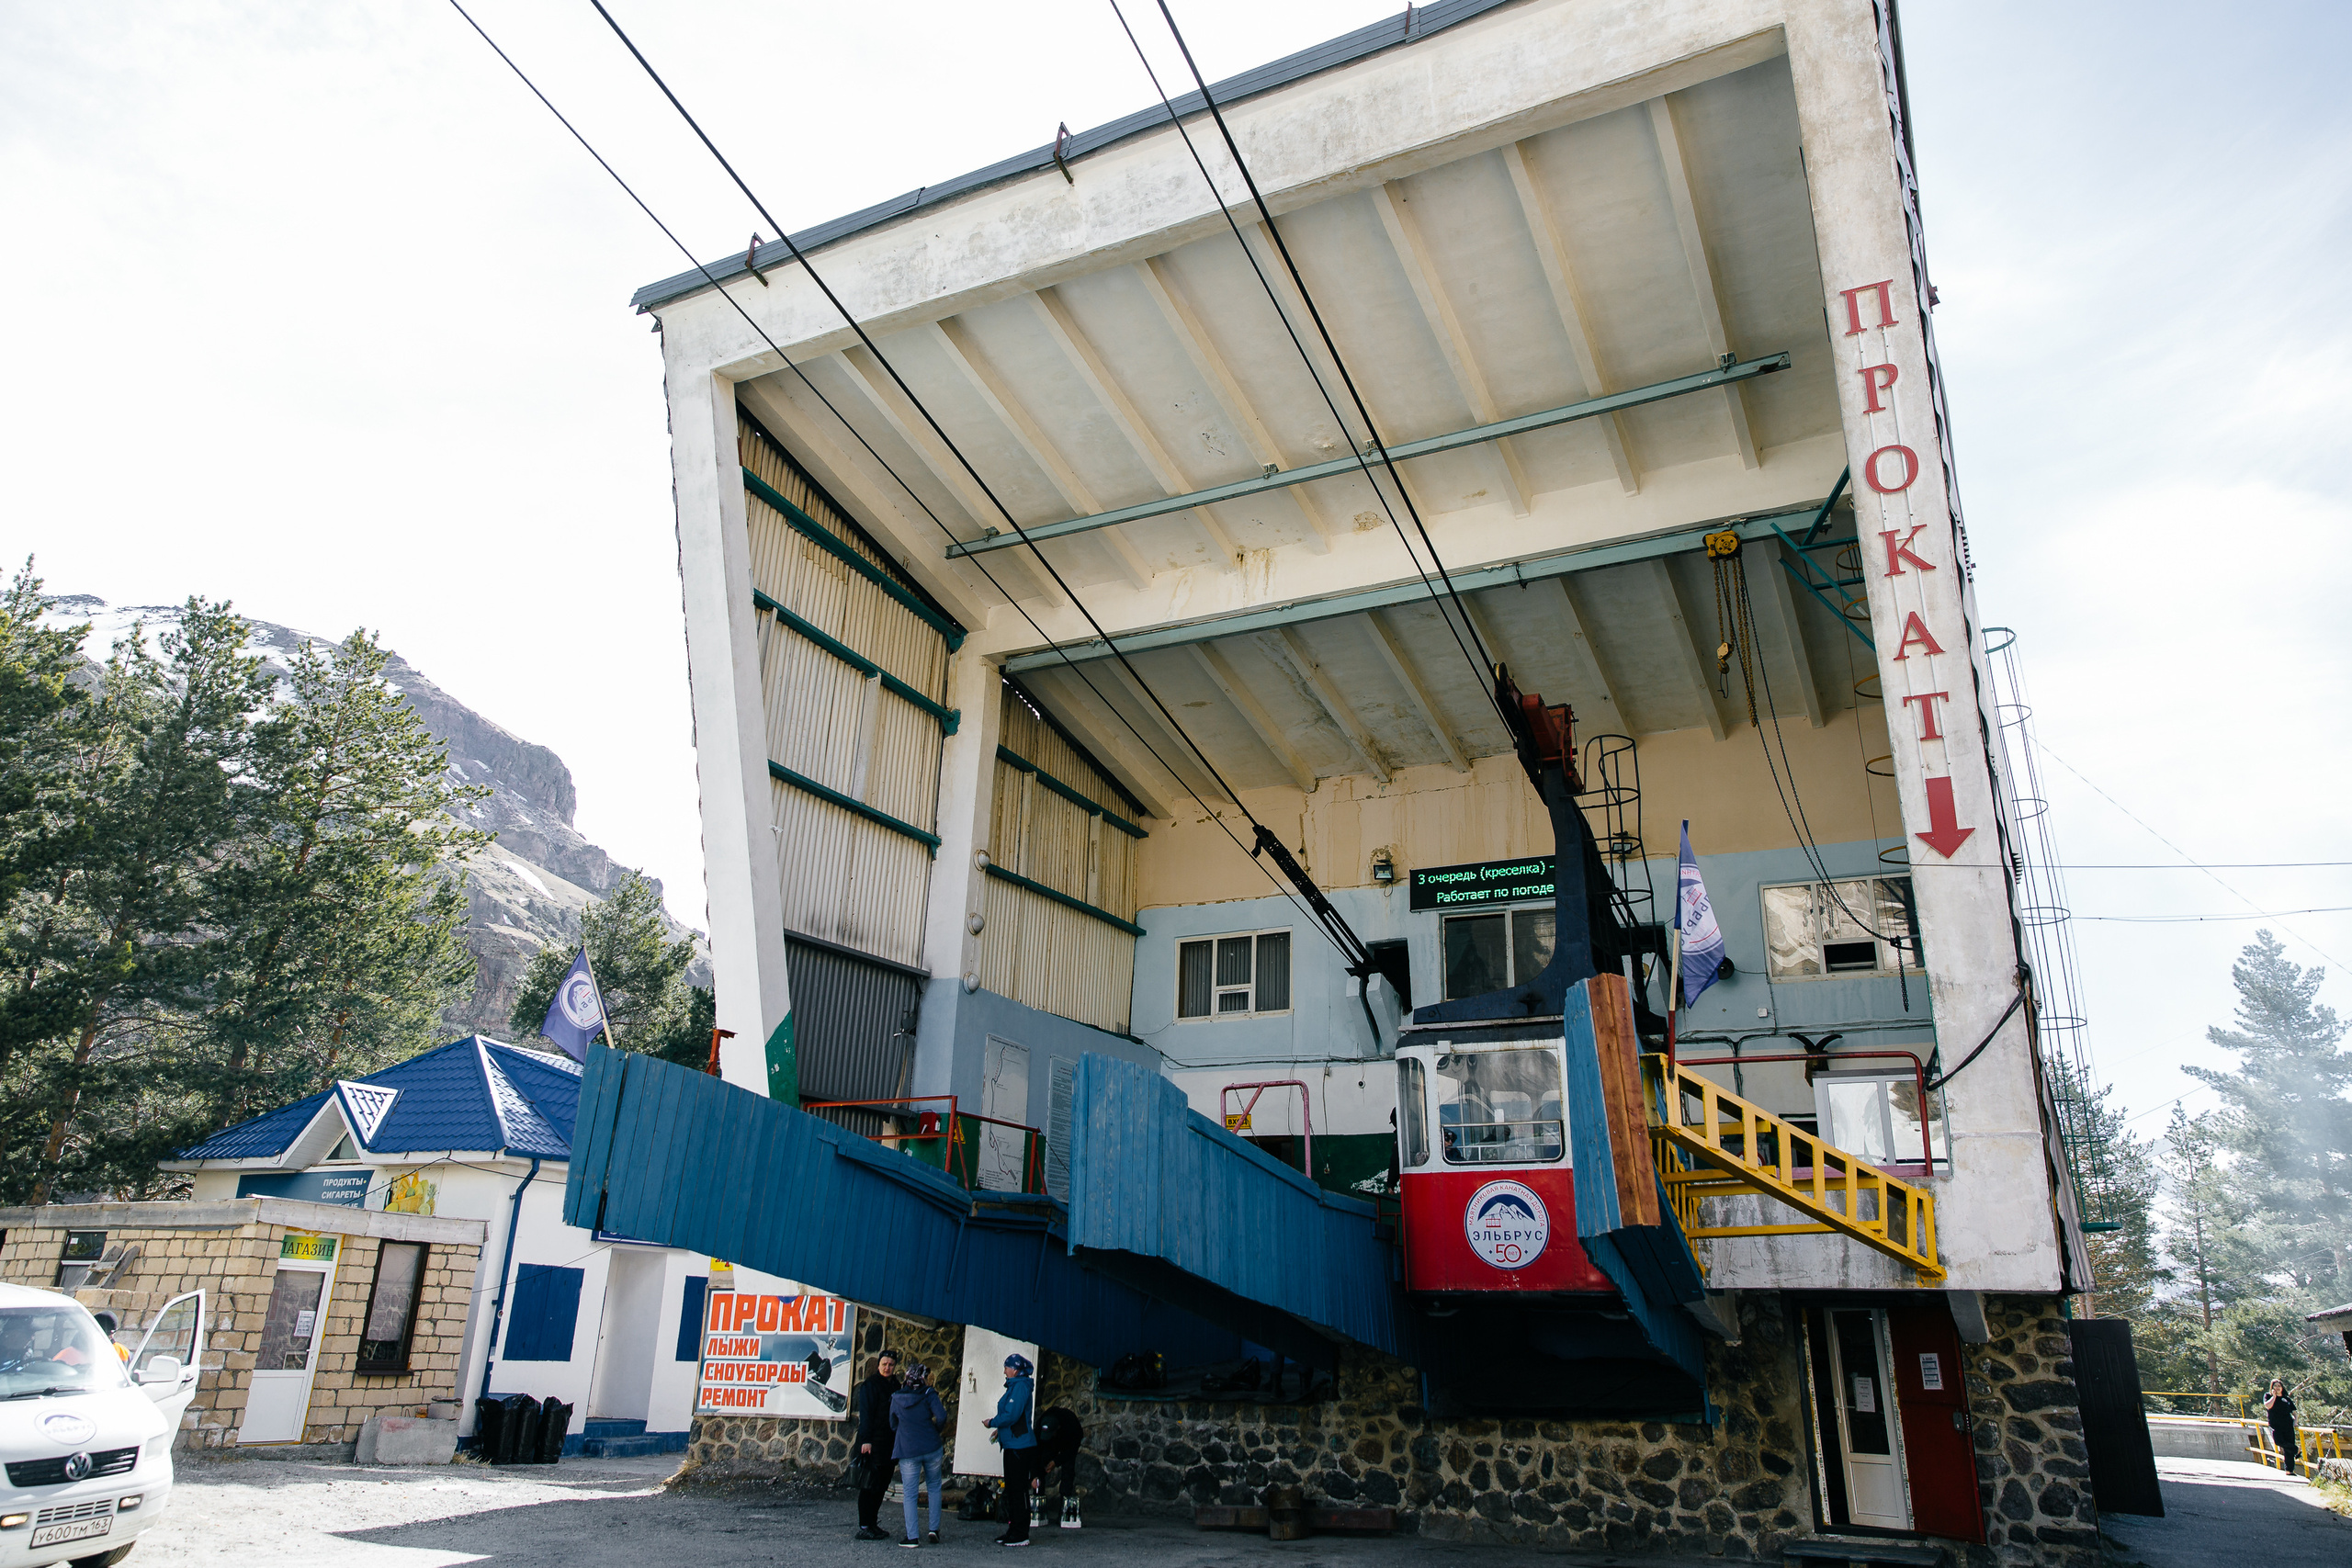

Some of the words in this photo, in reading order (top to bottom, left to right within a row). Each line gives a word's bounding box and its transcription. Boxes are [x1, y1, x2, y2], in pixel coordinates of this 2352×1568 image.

[1839, 279, 1950, 741] ПРОКАТ
[1418, 874, 1426, 885] 3
[1428, 870, 1476, 885] очередь
[1480, 861, 1545, 880] (креселка)
[1436, 888, 1491, 903] Работает
[1494, 887, 1509, 898] по
[1512, 884, 1555, 897] погоде
[322, 1178, 364, 1187] ПРОДУКТЫ
[321, 1190, 361, 1199] СИГАРЕТЫ
[1469, 1185, 1499, 1226] МАЯТНИКОВАЯ
[1499, 1184, 1533, 1201] КАНАТНАЯ
[1531, 1201, 1545, 1227] ДОРОГА
[1473, 1230, 1543, 1241] ЭЛЬБРУС
[1496, 1244, 1521, 1263] 50
[708, 1292, 851, 1333] ПРОКАТ
[707, 1337, 760, 1357] ЛЫЖИ
[704, 1362, 808, 1383] СНОУБОРДЫ
[701, 1387, 768, 1407] РЕМОНТ
[91, 1518, 108, 1529] 163
